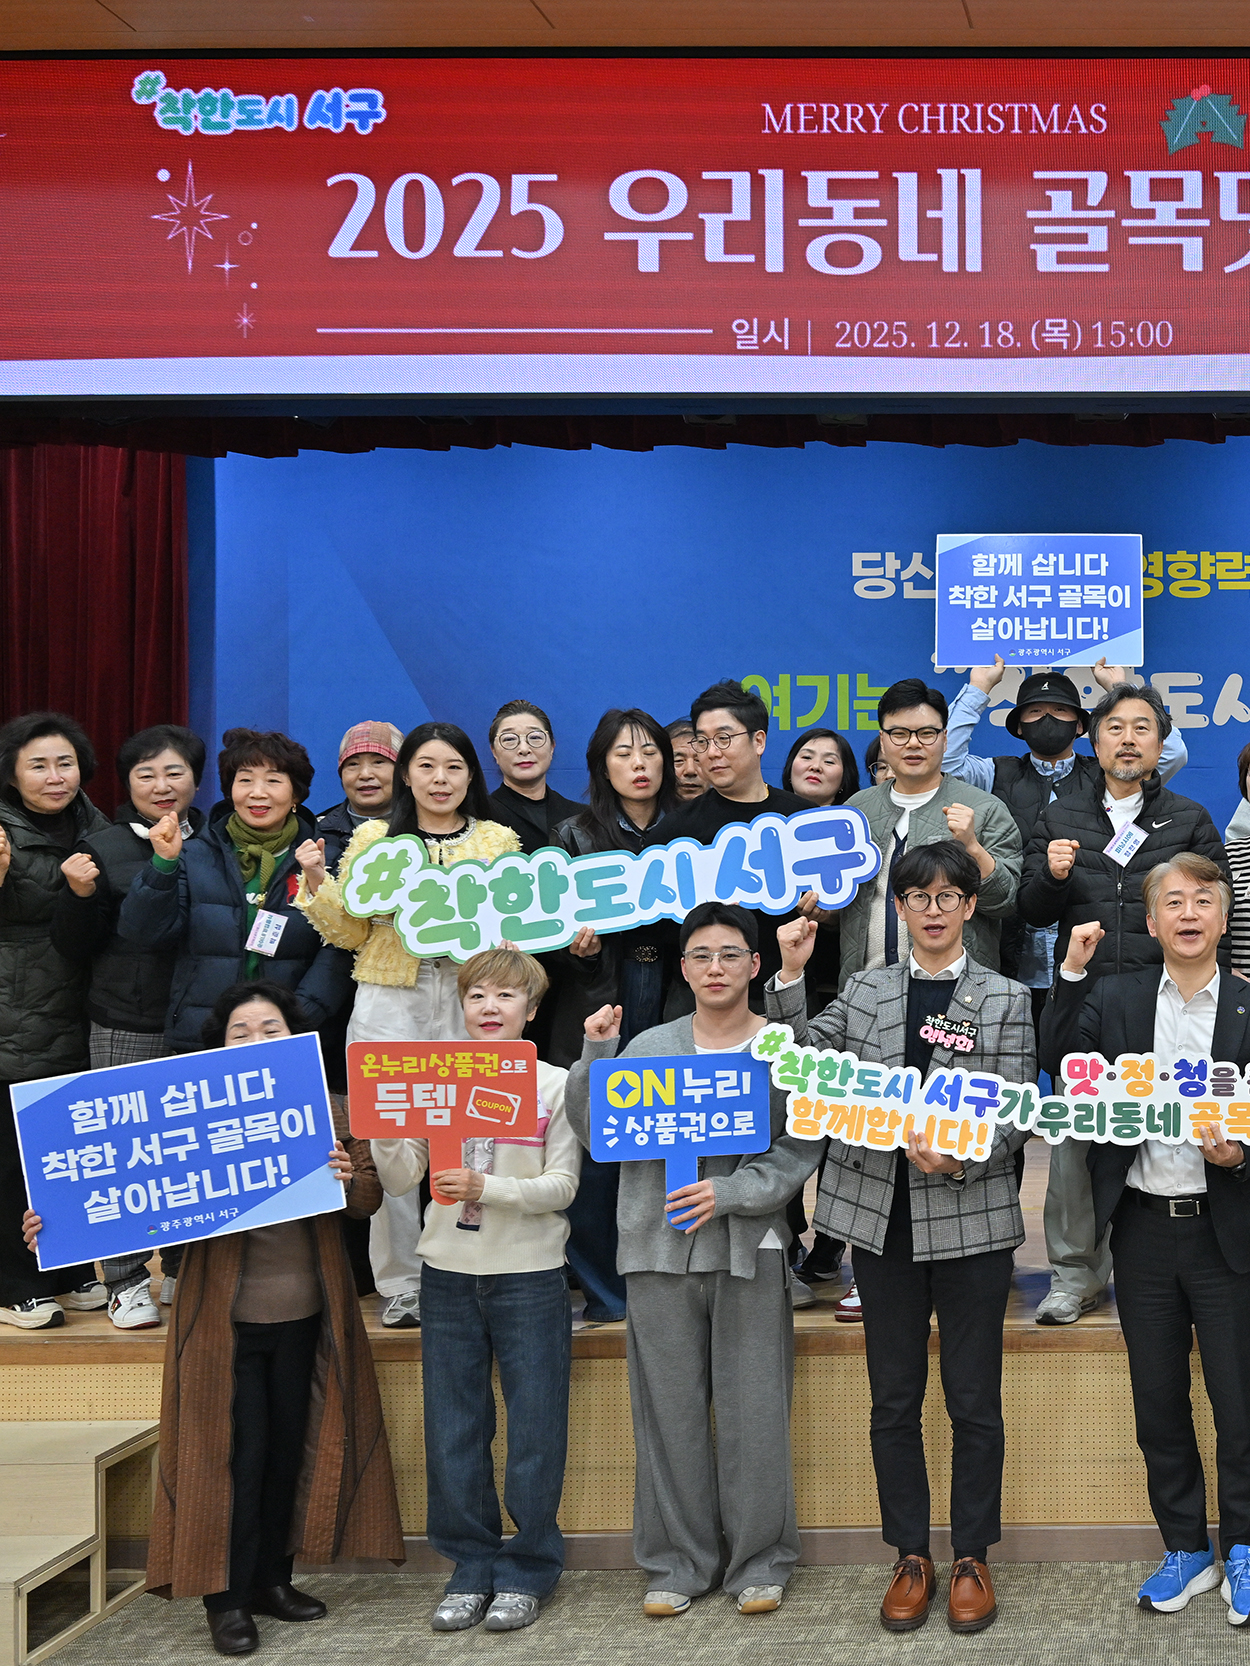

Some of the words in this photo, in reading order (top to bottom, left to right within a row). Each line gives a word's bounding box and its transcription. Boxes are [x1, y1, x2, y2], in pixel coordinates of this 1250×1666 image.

[133, 72, 298, 133] #착한도시
[305, 88, 385, 133] 서구
[761, 102, 889, 134] MERRY
[898, 102, 1108, 134] CHRISTMAS
[325, 171, 565, 260] 2025
[603, 167, 983, 276] 우리동네
[731, 317, 791, 351] 일시
[834, 321, 917, 350] 2025.
[926, 321, 972, 350] 12.
[980, 321, 1022, 350] 18.
[1029, 317, 1083, 352] (목)
[1092, 320, 1173, 350] 15:00
[972, 553, 1022, 577] 함께
[1031, 553, 1108, 577] 삽니다
[949, 585, 997, 608] 착한
[1003, 585, 1053, 608] 서구
[1058, 584, 1131, 608] 골목이
[971, 616, 1109, 641] 살아납니다!
[1017, 648, 1056, 657] 광주광역시
[1058, 648, 1071, 656] 서구
[356, 848, 697, 951] #착한도시
[714, 819, 867, 900] 서구
[360, 1051, 528, 1078] 온누리상품권으로
[757, 1030, 914, 1104] #착한도시
[924, 1073, 1035, 1125] 서구가
[68, 1090, 149, 1135] 함께
[160, 1068, 276, 1119] 삽니다
[375, 1082, 456, 1126] 득템
[475, 1098, 513, 1114] COUPON
[1036, 1100, 1181, 1139] 우리동네
[41, 1142, 117, 1182] 착한
[127, 1126, 200, 1169] 서구
[206, 1104, 316, 1155] 골목이
[625, 1111, 756, 1147] 상품권으로
[792, 1099, 988, 1157] 함께합니다!
[83, 1154, 291, 1225] 살아납니다!
[159, 1211, 216, 1233] 광주광역시
[218, 1207, 240, 1219] 서구
